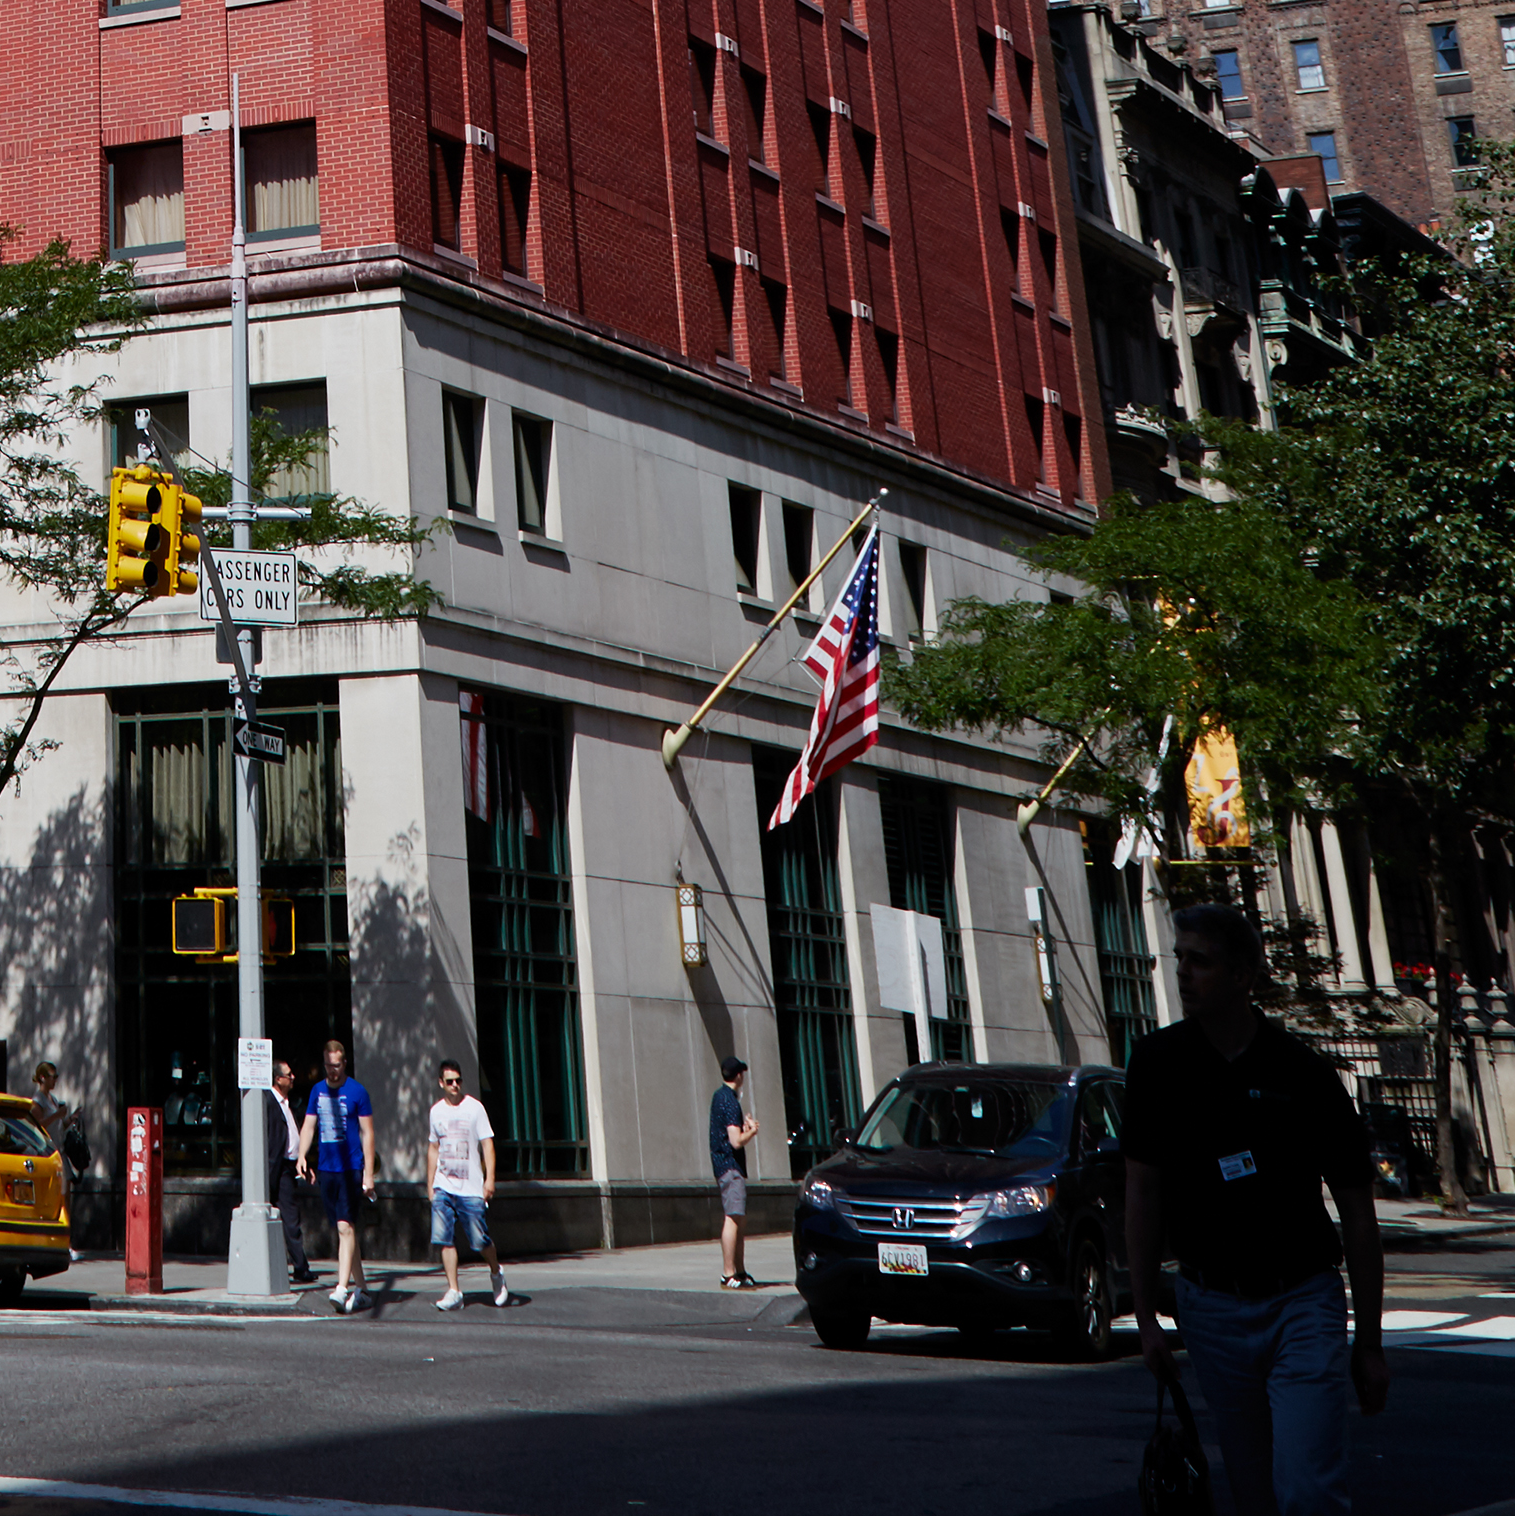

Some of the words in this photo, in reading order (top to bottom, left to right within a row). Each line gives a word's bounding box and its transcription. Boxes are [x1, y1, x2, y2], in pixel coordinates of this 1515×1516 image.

[208, 560, 290, 583] ASSENGER
[207, 587, 244, 608] CRS
[255, 589, 290, 611] ONLY
[243, 730, 257, 748] ONE
[264, 735, 280, 753] WAY
